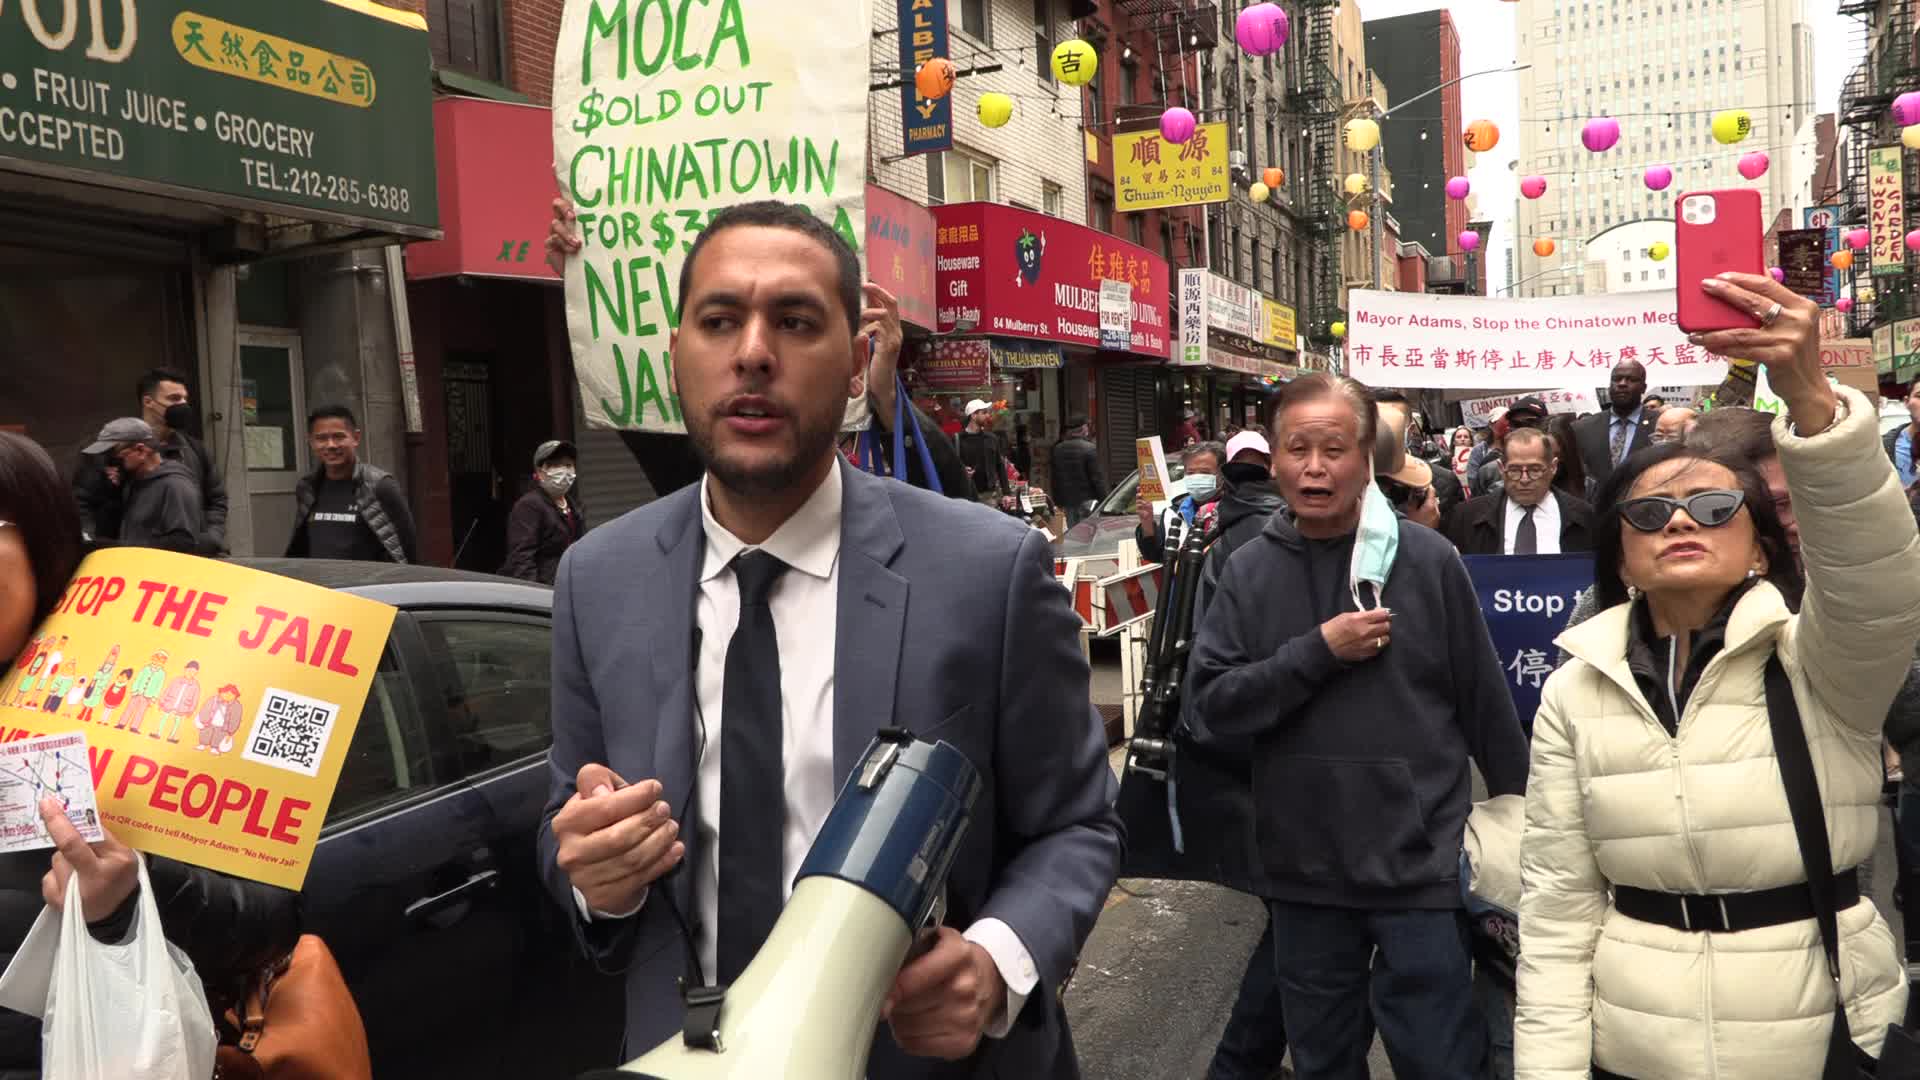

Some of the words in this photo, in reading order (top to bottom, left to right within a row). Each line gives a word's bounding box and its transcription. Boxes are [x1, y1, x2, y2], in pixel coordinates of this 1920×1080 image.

[183, 19, 374, 102] 天然食品公司
[581, 0, 750, 86] MOCA
[1057, 50, 1083, 74] 吉
[33, 67, 110, 116] FRUIT
[121, 88, 188, 132] JUICE
[214, 111, 315, 158] GROCERY
[694, 82, 773, 116] OUT
[908, 124, 946, 142] PHARMACY
[240, 158, 410, 214] TEL:212-285-6388
[569, 136, 839, 208] CHINATOWN
[576, 210, 643, 250] FOR
[1871, 187, 1886, 257] WONTON
[1887, 189, 1903, 263] GARDEN
[937, 255, 980, 271] Houseware
[949, 280, 968, 297] Gift
[993, 317, 1004, 329] 84
[1005, 317, 1039, 335] Mulberry
[1356, 310, 1403, 328] Mayor
[1408, 314, 1467, 330] Adams,
[1472, 316, 1509, 331] Stop
[1514, 318, 1540, 330] the
[1545, 315, 1637, 330] Chinatown
[1493, 588, 1565, 617] Stop
[132, 580, 228, 638] THE
[238, 605, 360, 678] JAIL
[112, 754, 311, 846] PEOPLE
[117, 815, 131, 827] QR
[131, 819, 153, 833] code
[153, 824, 164, 834] to
[164, 826, 180, 839] tell
[179, 831, 209, 847] Mayor
[209, 838, 239, 854] Adams
[256, 850, 280, 864] New
